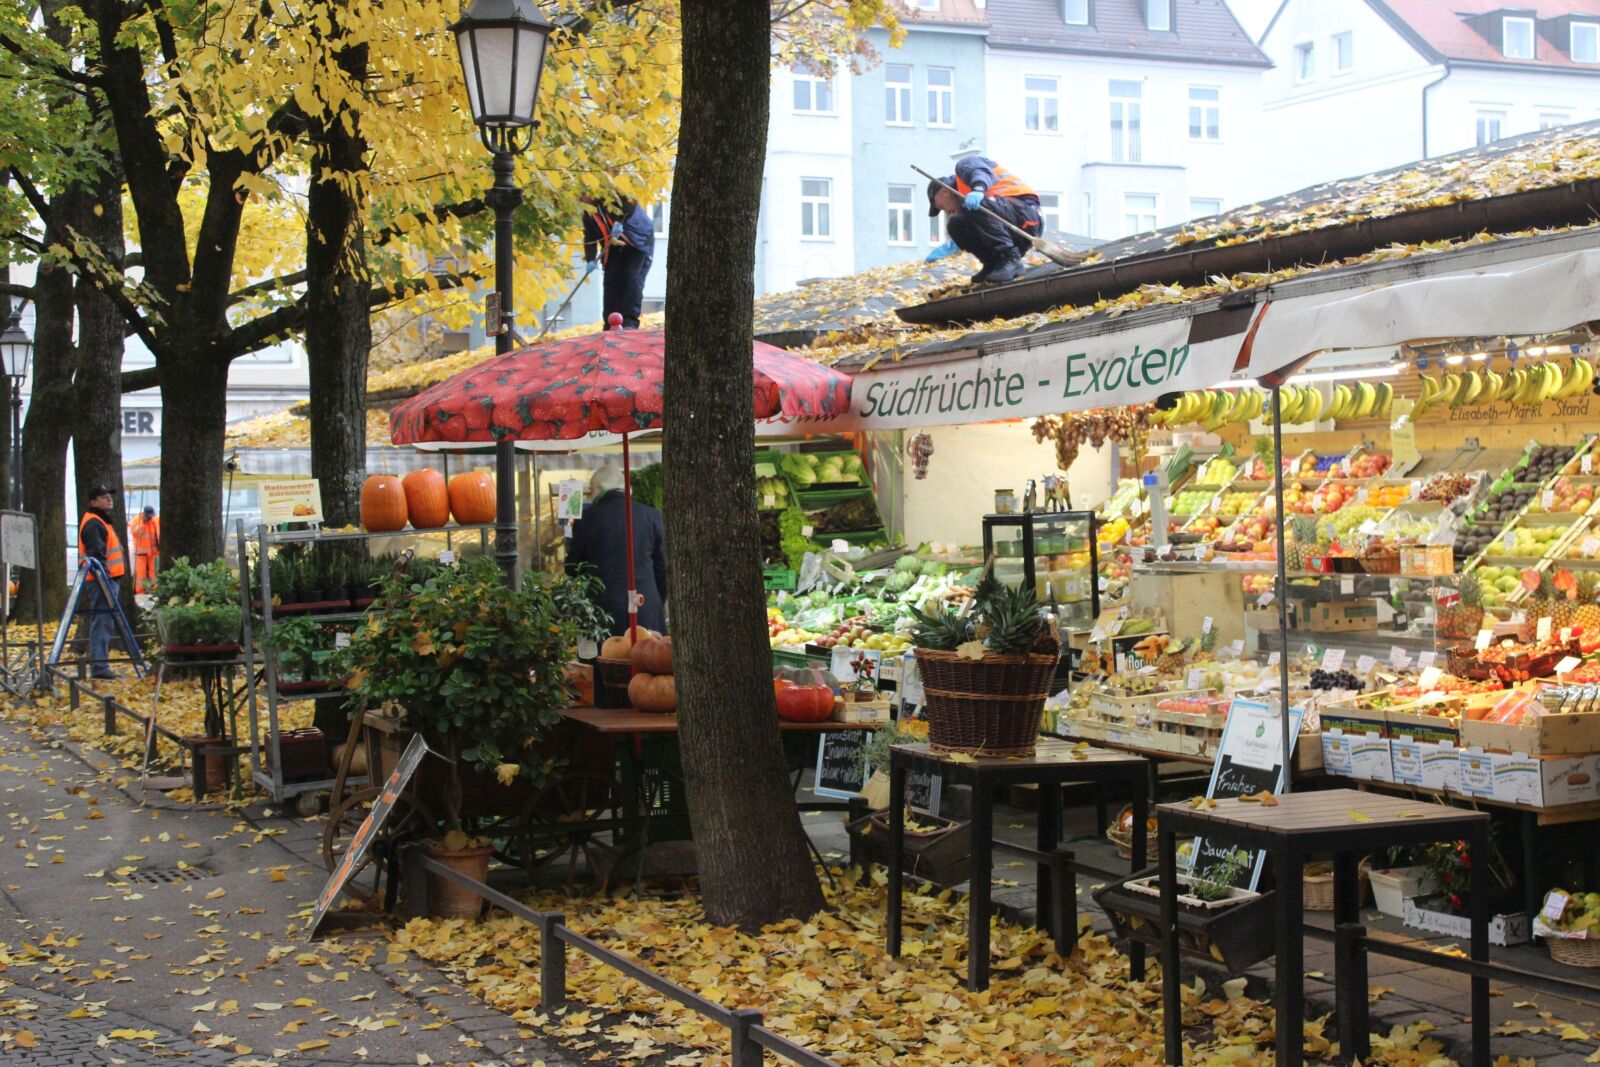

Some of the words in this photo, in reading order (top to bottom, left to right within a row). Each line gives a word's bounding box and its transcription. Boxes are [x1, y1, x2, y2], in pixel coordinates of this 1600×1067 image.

[860, 366, 1025, 419] Südfrüchte
[1063, 343, 1190, 398] Exoten
[1551, 399, 1590, 417] Stand
[123, 411, 154, 433] ER
[1216, 768, 1257, 793] Frisches
